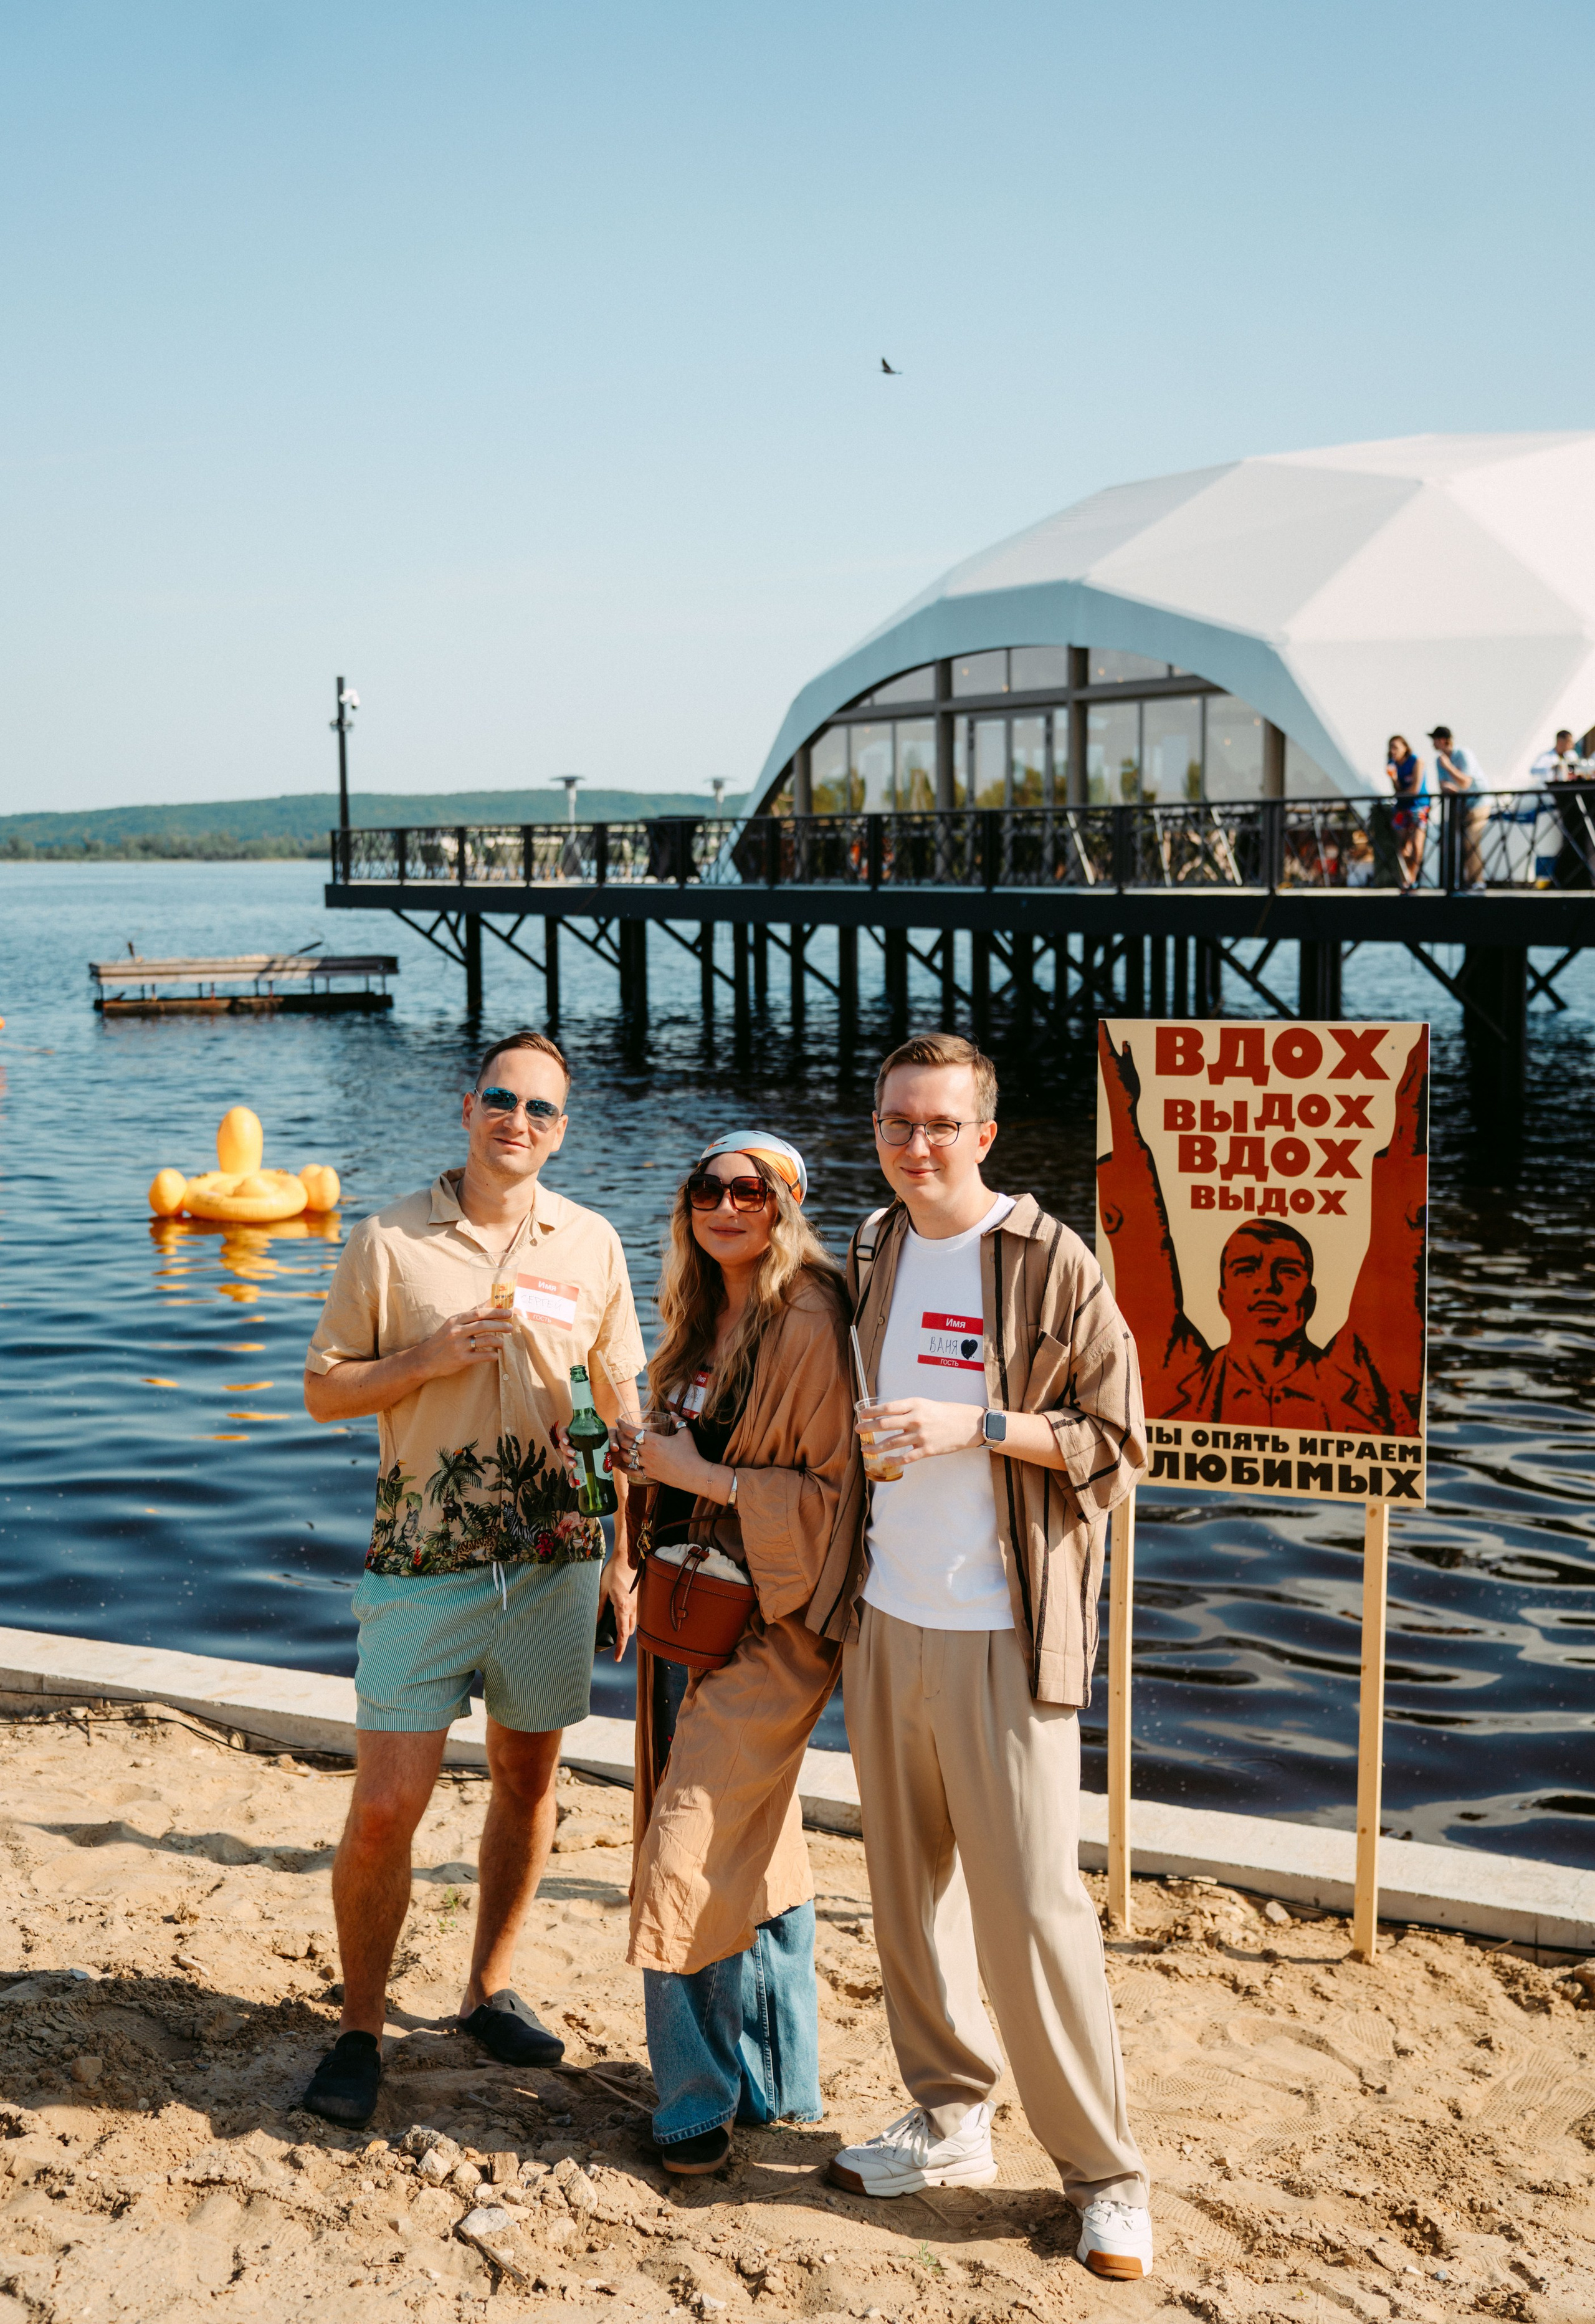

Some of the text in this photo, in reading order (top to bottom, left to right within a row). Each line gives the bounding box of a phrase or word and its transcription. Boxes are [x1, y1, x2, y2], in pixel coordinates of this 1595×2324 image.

[1155, 1026, 1391, 1086] ВДОХ
[1163, 1093, 1375, 1134] ВЫДОХ
[1178, 1134, 1363, 1182] ВДОХ
[1191, 1185, 1348, 1217] ВЫДОХ
[538, 1281, 557, 1292] Имя
[533, 1314, 552, 1323] ГОСТЬ
[946, 1318, 966, 1328] Имя
[930, 1336, 958, 1355] ВАНЯ
[940, 1359, 959, 1367] ГОСТЬ
[1191, 1430, 1290, 1453] ОПЯТЬ
[1299, 1437, 1422, 1464] ИГРАЕМ
[1148, 1450, 1422, 1500] ЛЮБИМЫХ
